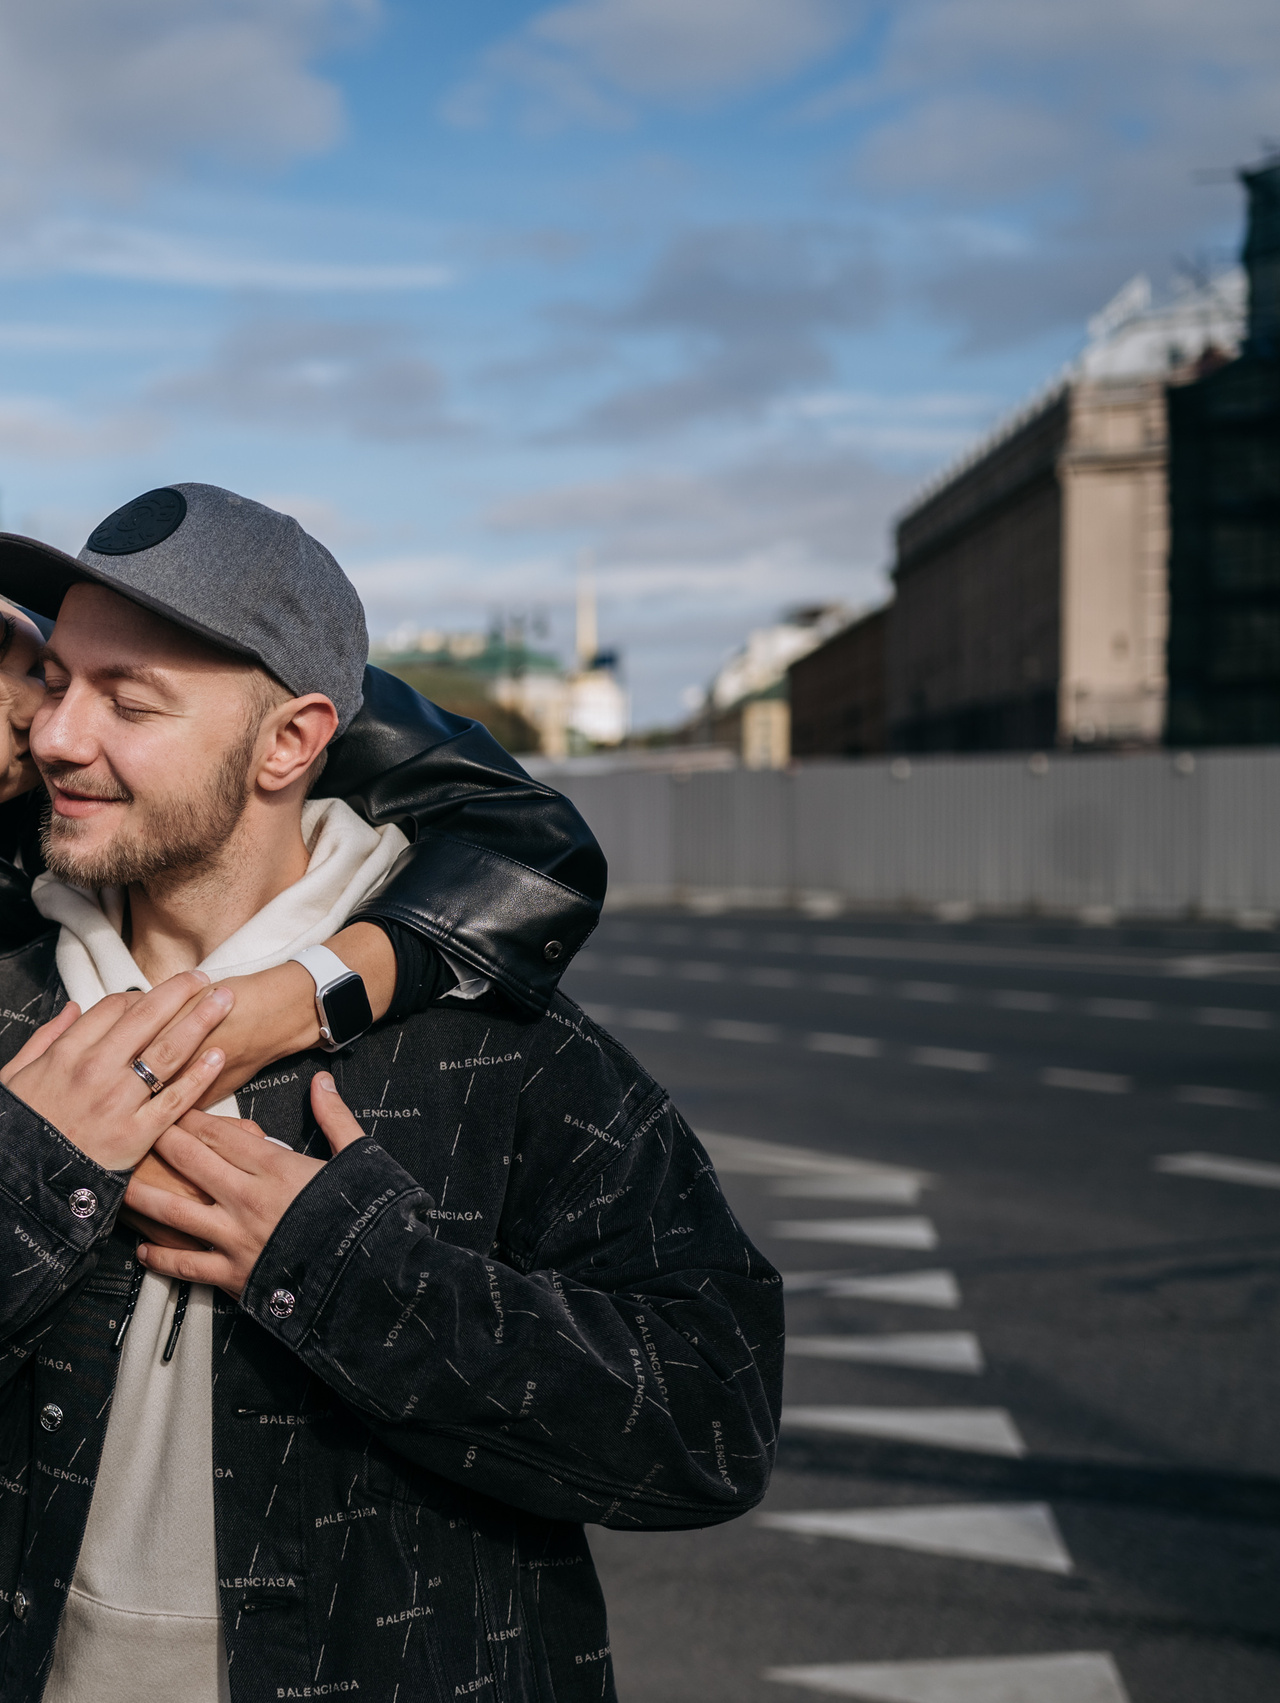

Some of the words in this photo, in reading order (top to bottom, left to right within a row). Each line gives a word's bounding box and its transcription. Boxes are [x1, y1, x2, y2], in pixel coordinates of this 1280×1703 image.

[439, 1051, 522, 1071] BALENCIAGA
[237, 1072, 300, 1095] ENCIAGA
[354, 1107, 421, 1119] LENCIAGA
[335, 1188, 396, 1257] BALENCIAGA
[427, 1209, 483, 1221] ENCIAGA
[621, 1348, 646, 1434] BALENCIAGA
[277, 1679, 360, 1698] BALENCIAGA
